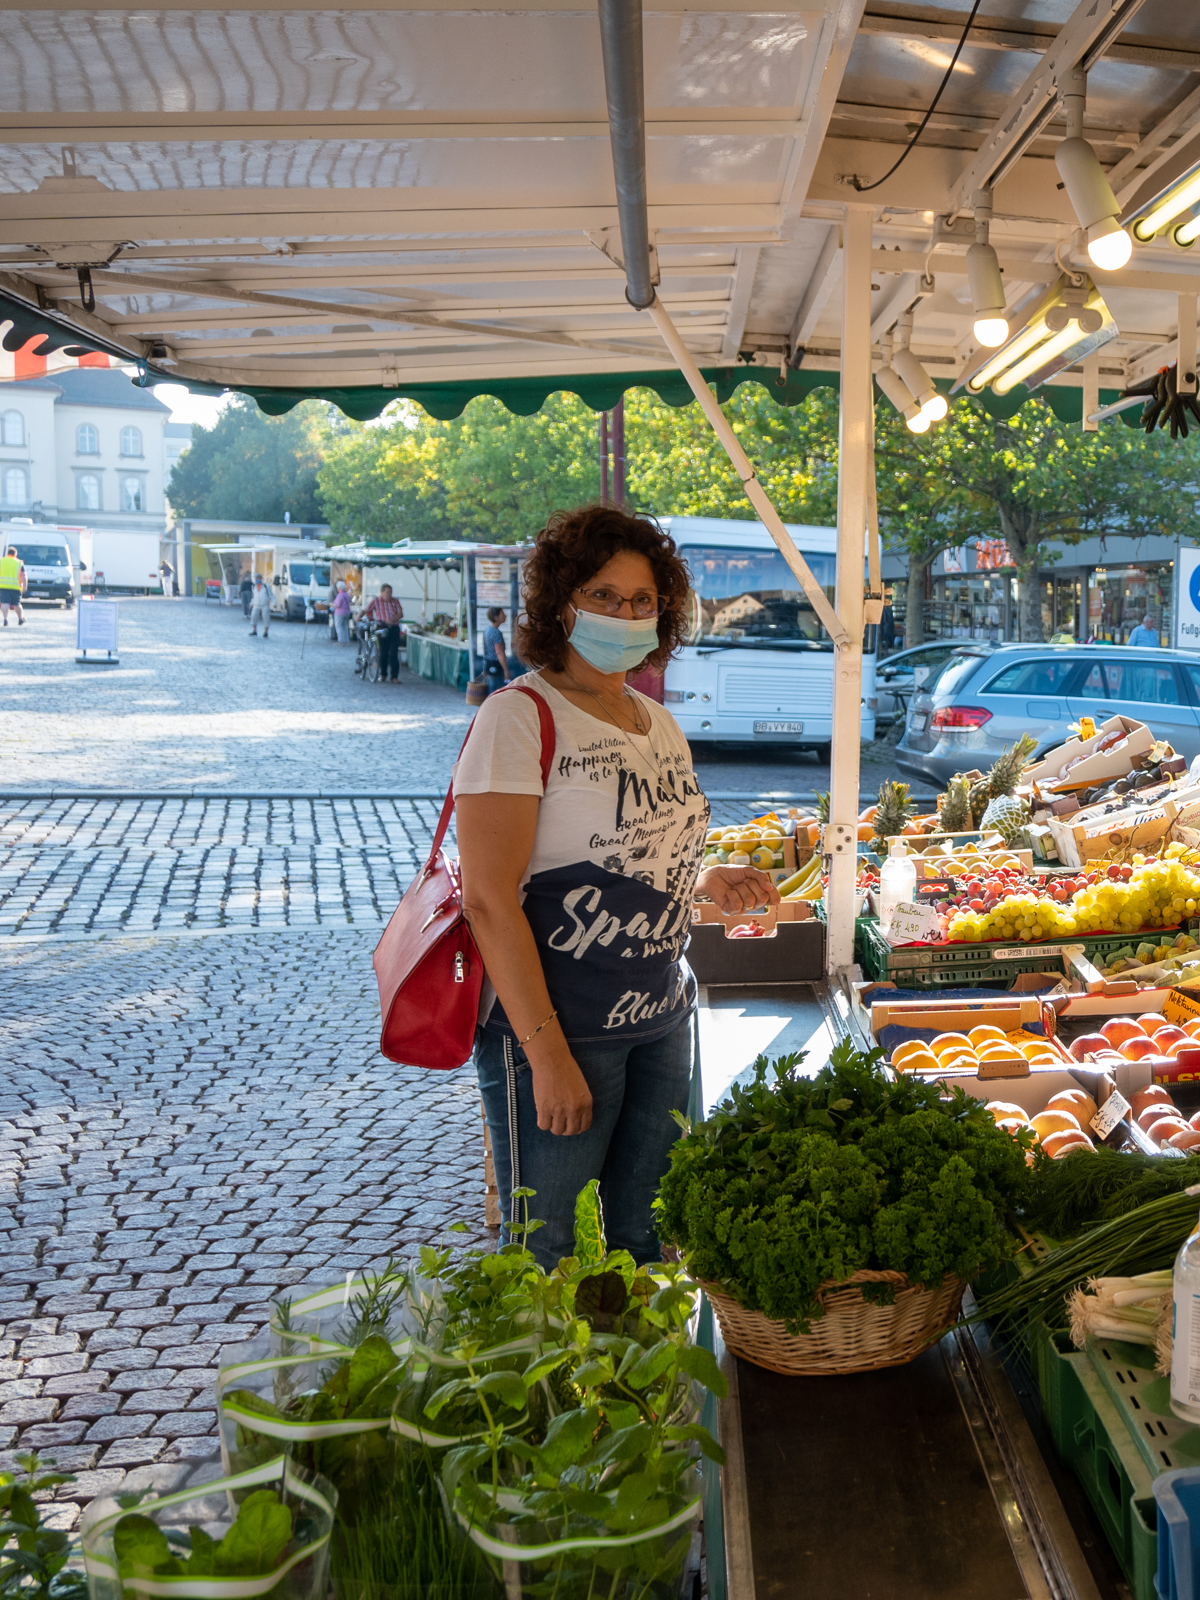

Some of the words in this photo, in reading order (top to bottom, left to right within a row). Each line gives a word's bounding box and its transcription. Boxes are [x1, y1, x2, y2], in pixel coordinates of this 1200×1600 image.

[755, 722, 767, 731] BB
[589, 833, 630, 849] Great
[602, 990, 668, 1029] Blue
